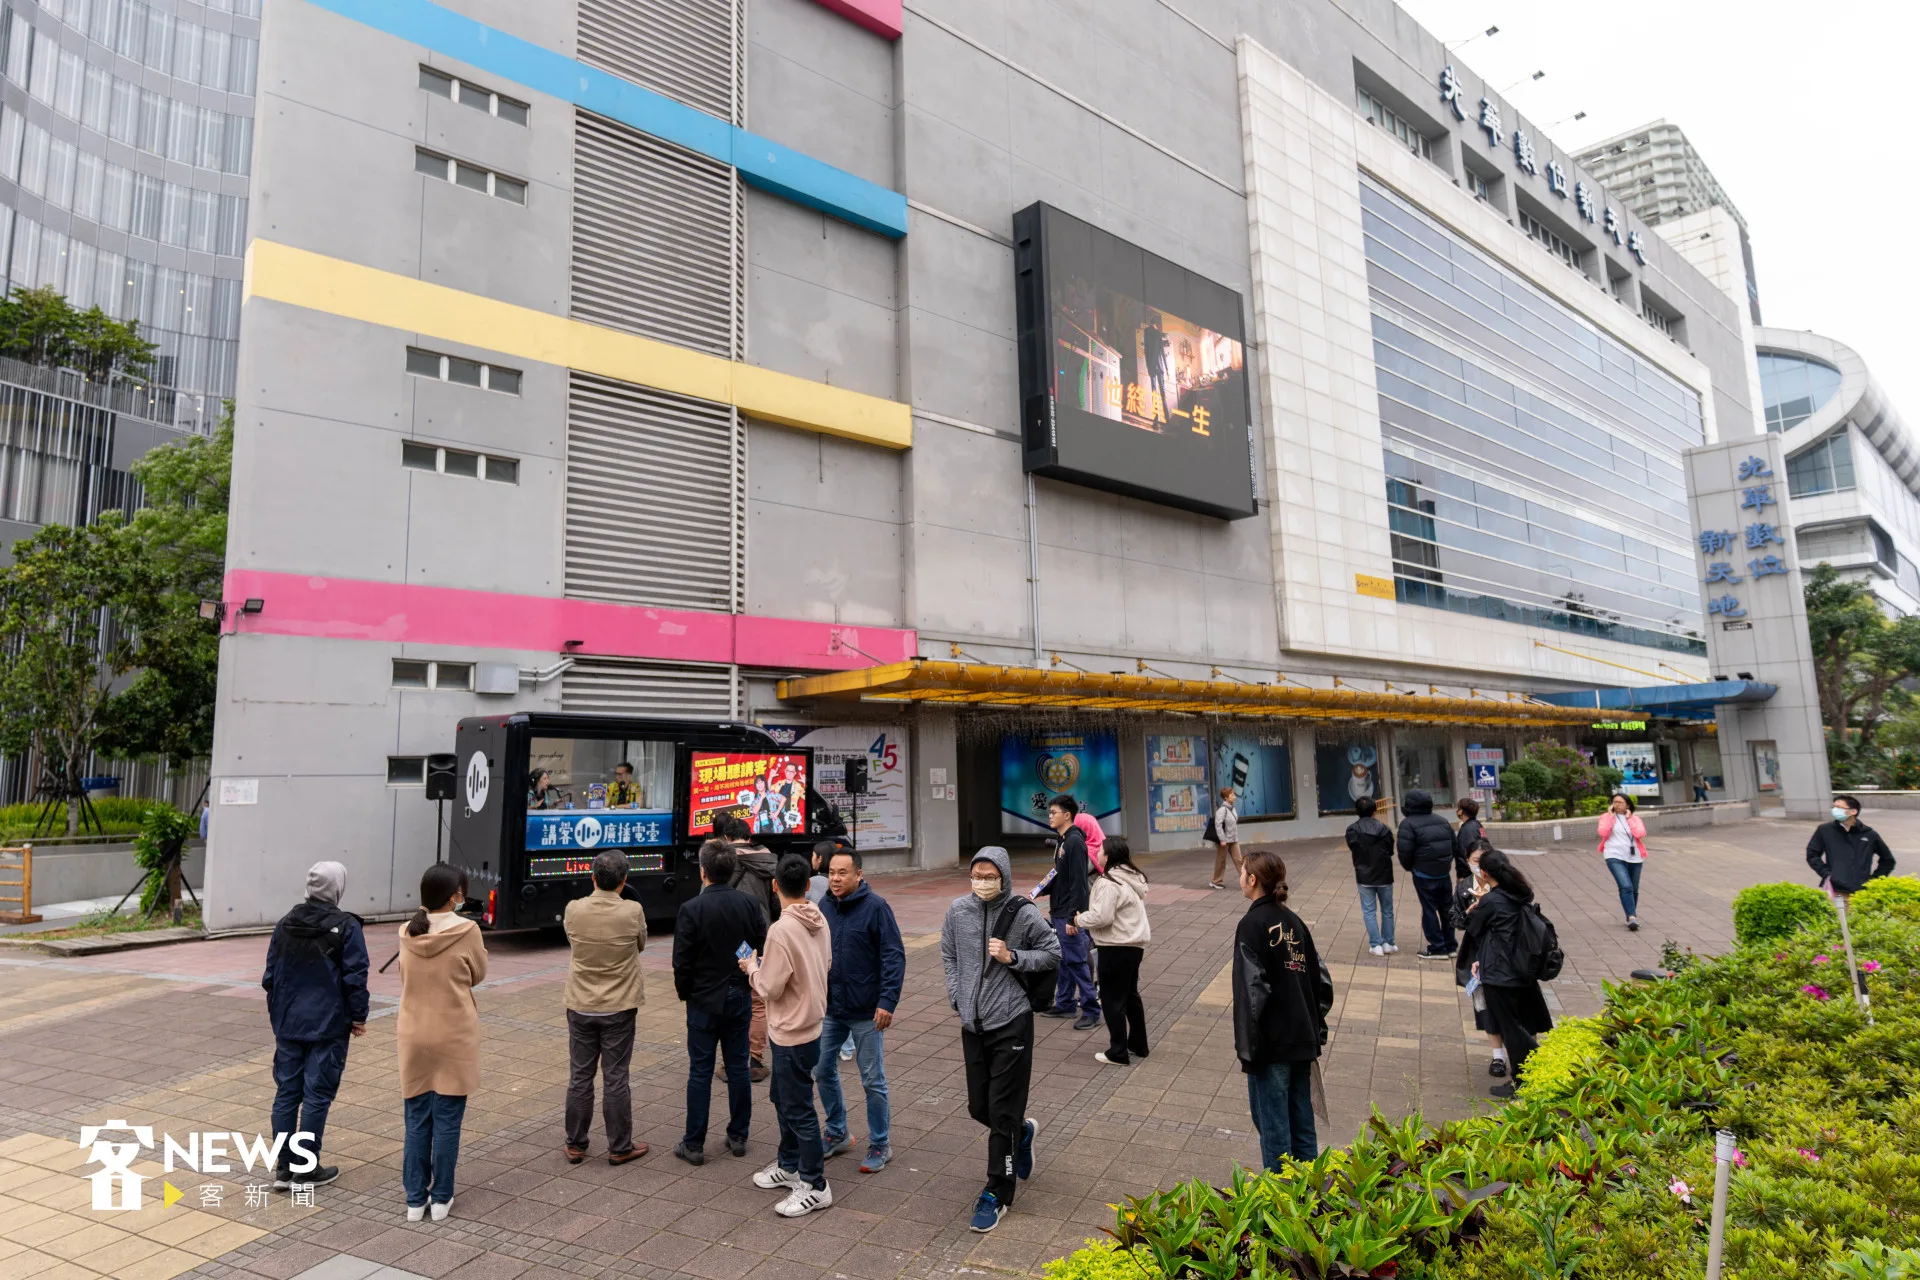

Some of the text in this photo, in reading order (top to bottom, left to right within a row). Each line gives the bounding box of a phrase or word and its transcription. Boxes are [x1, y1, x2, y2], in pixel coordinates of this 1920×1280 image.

[1738, 455, 1789, 581] 光華數位
[1699, 529, 1746, 617] 新天地
[814, 753, 867, 765] 華數位新
[698, 760, 767, 785] 現場聽講客
[603, 822, 660, 844] 廣播電臺
[566, 861, 591, 872] Live
